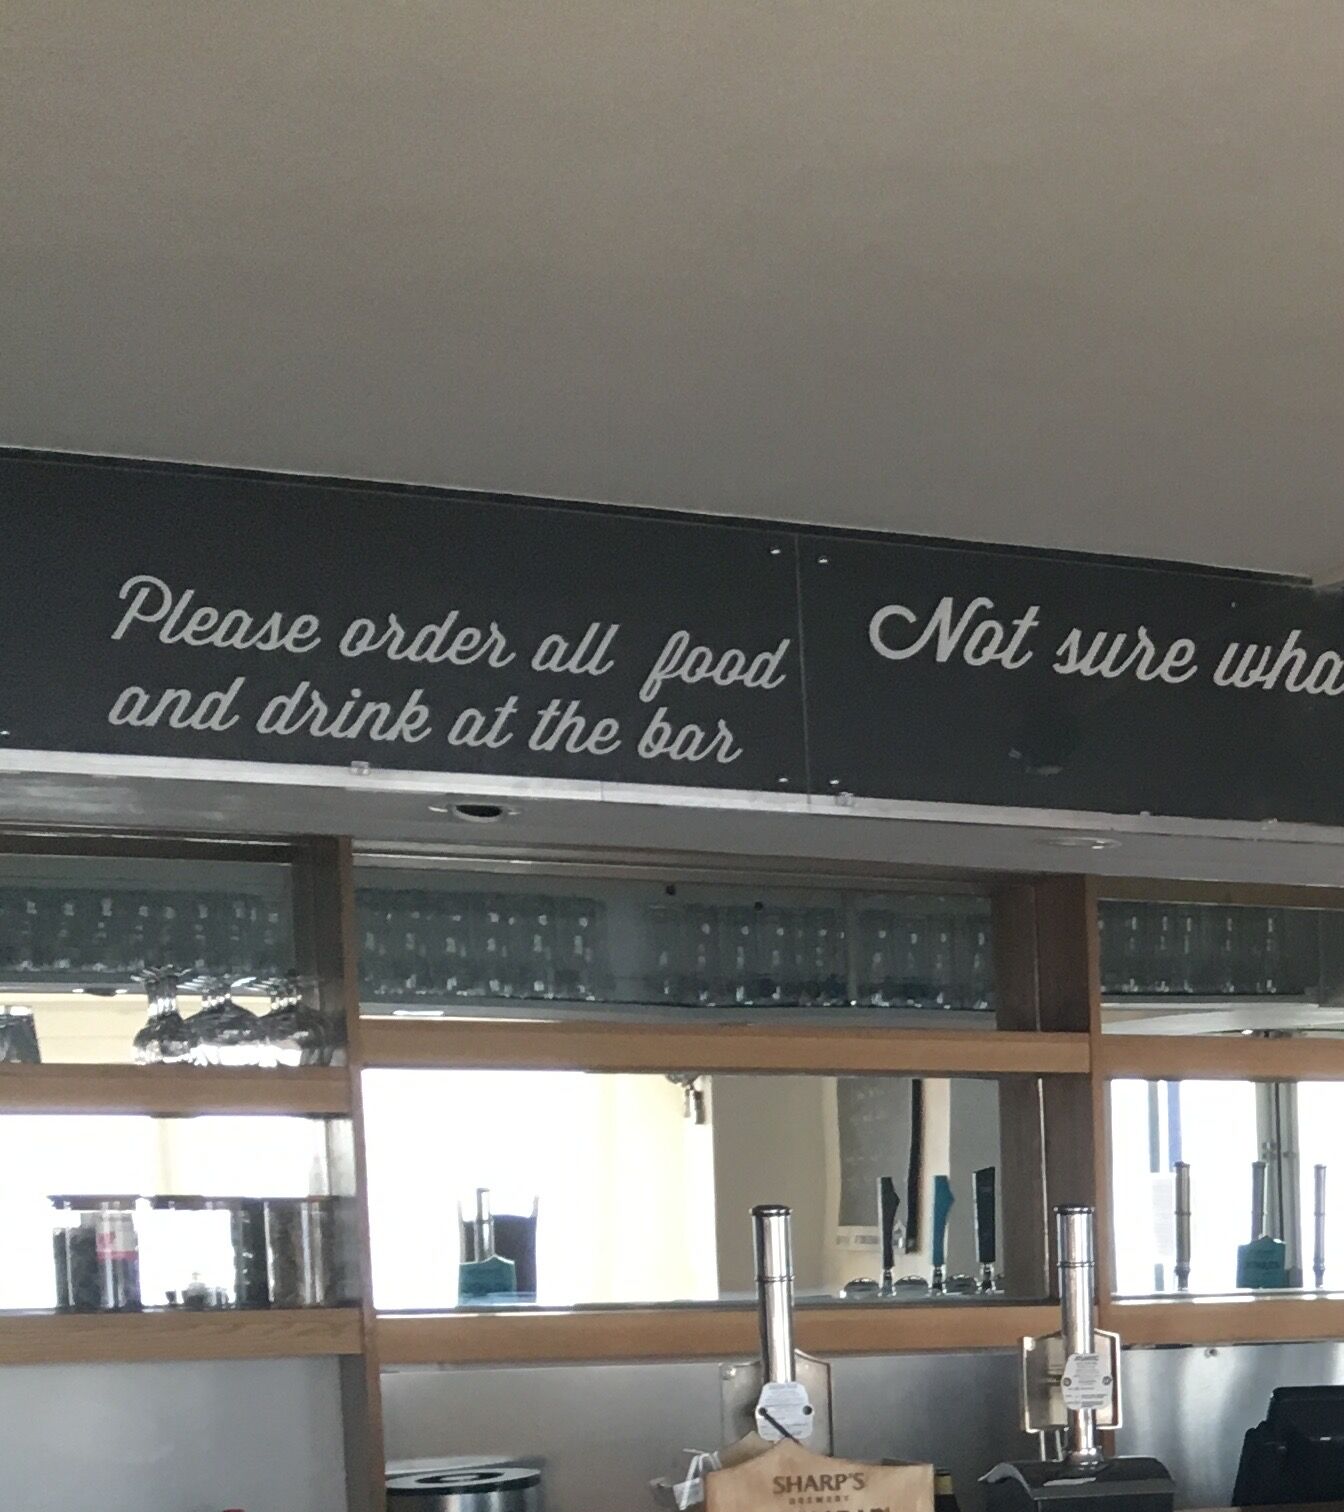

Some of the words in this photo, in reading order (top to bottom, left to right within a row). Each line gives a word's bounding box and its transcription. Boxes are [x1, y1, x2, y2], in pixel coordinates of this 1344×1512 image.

[110, 575, 322, 653] Please
[338, 611, 517, 668] order
[531, 622, 620, 676] all
[638, 630, 791, 703] food
[869, 596, 1040, 670] Not
[1052, 625, 1198, 684] sure
[108, 676, 246, 731] and
[255, 681, 433, 743] drink
[447, 695, 519, 749] at
[528, 698, 622, 755] the
[637, 706, 743, 764] bar
[772, 1472, 866, 1495] SHARP'S
